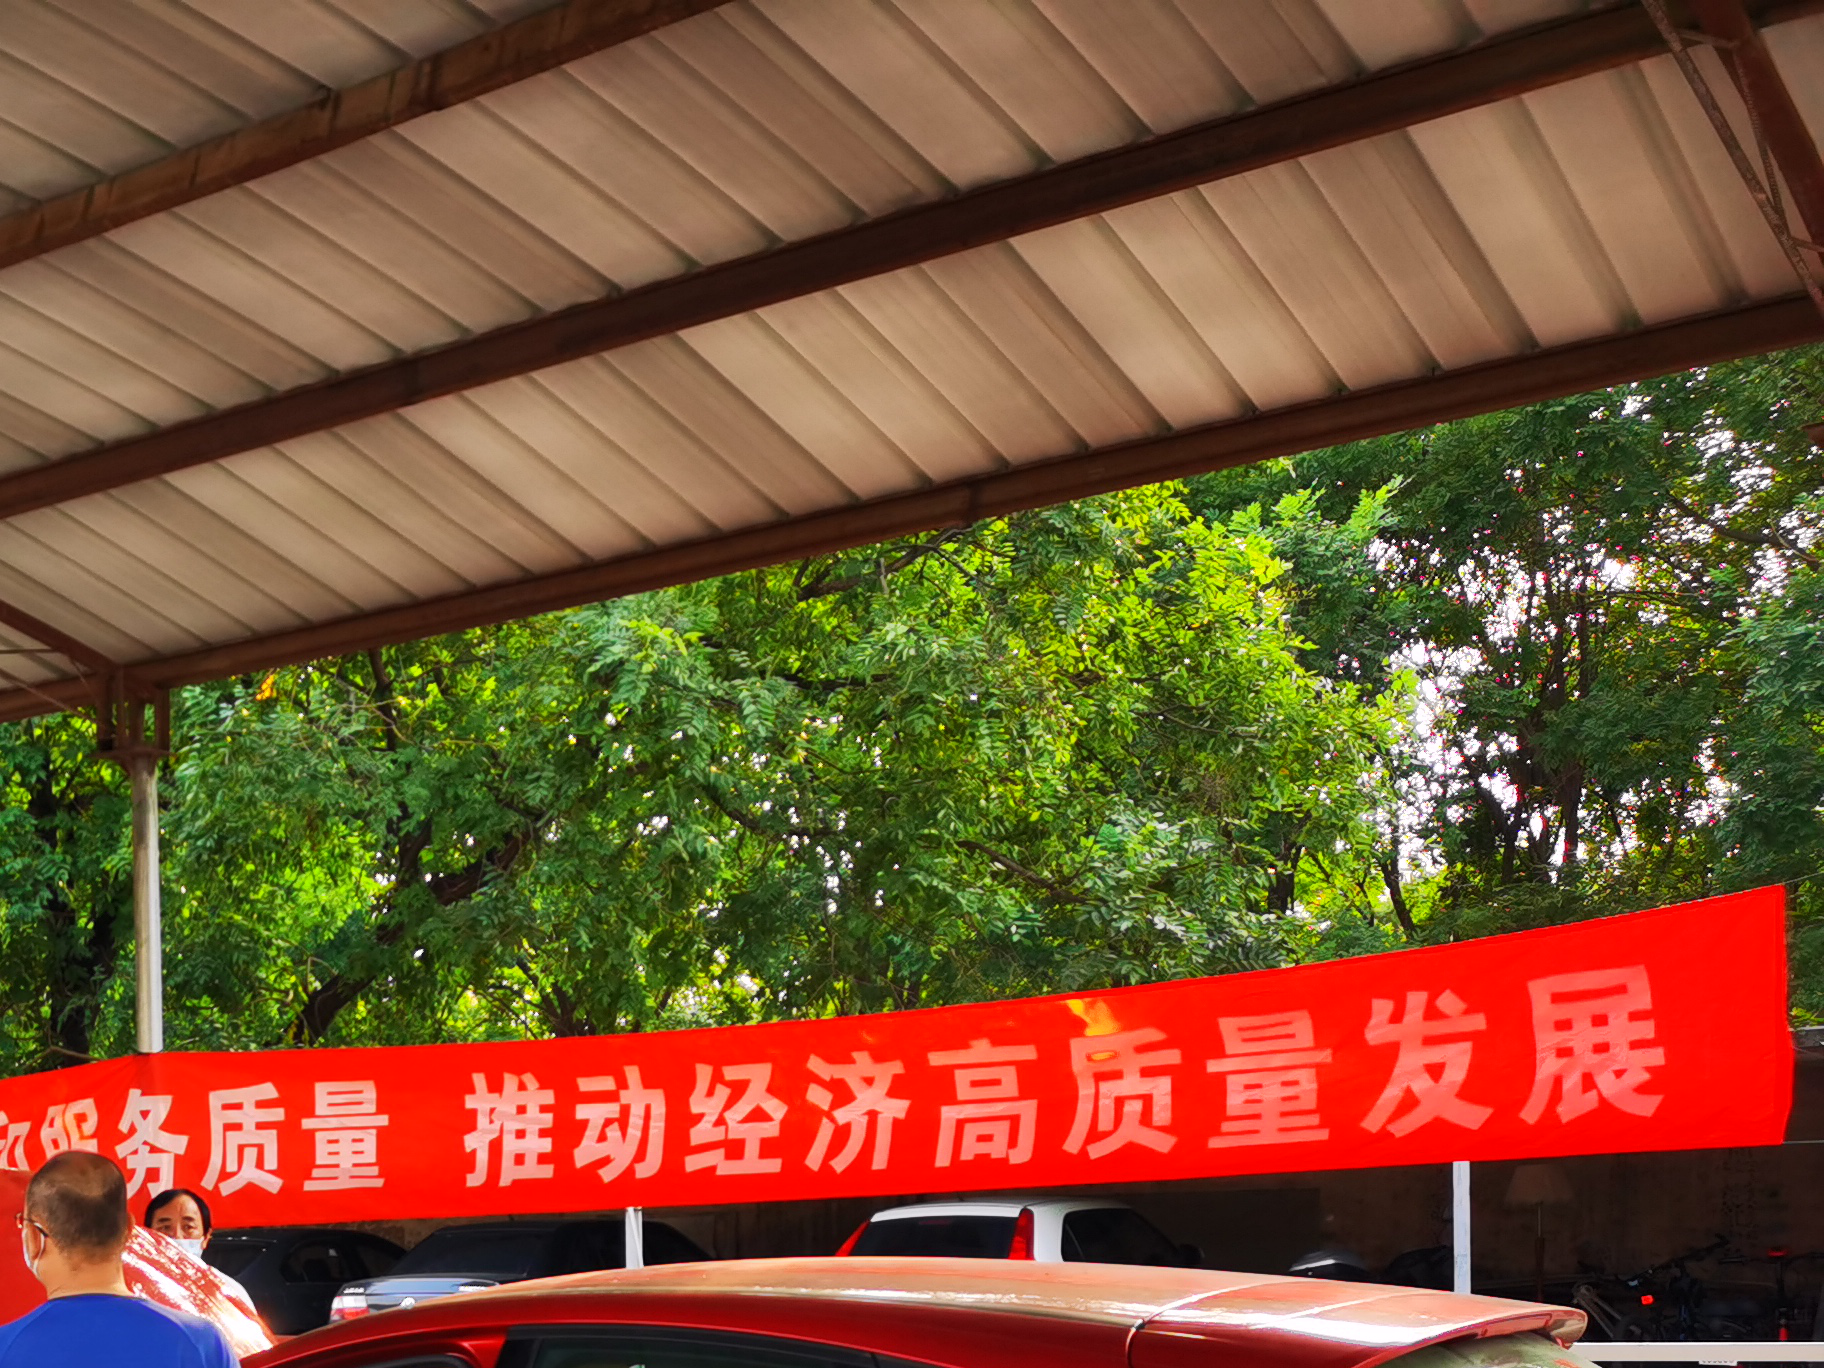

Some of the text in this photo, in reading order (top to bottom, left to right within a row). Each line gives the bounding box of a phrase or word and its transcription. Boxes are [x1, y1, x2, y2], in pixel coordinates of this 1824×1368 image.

[463, 964, 1665, 1187] 推动经济高质量发展
